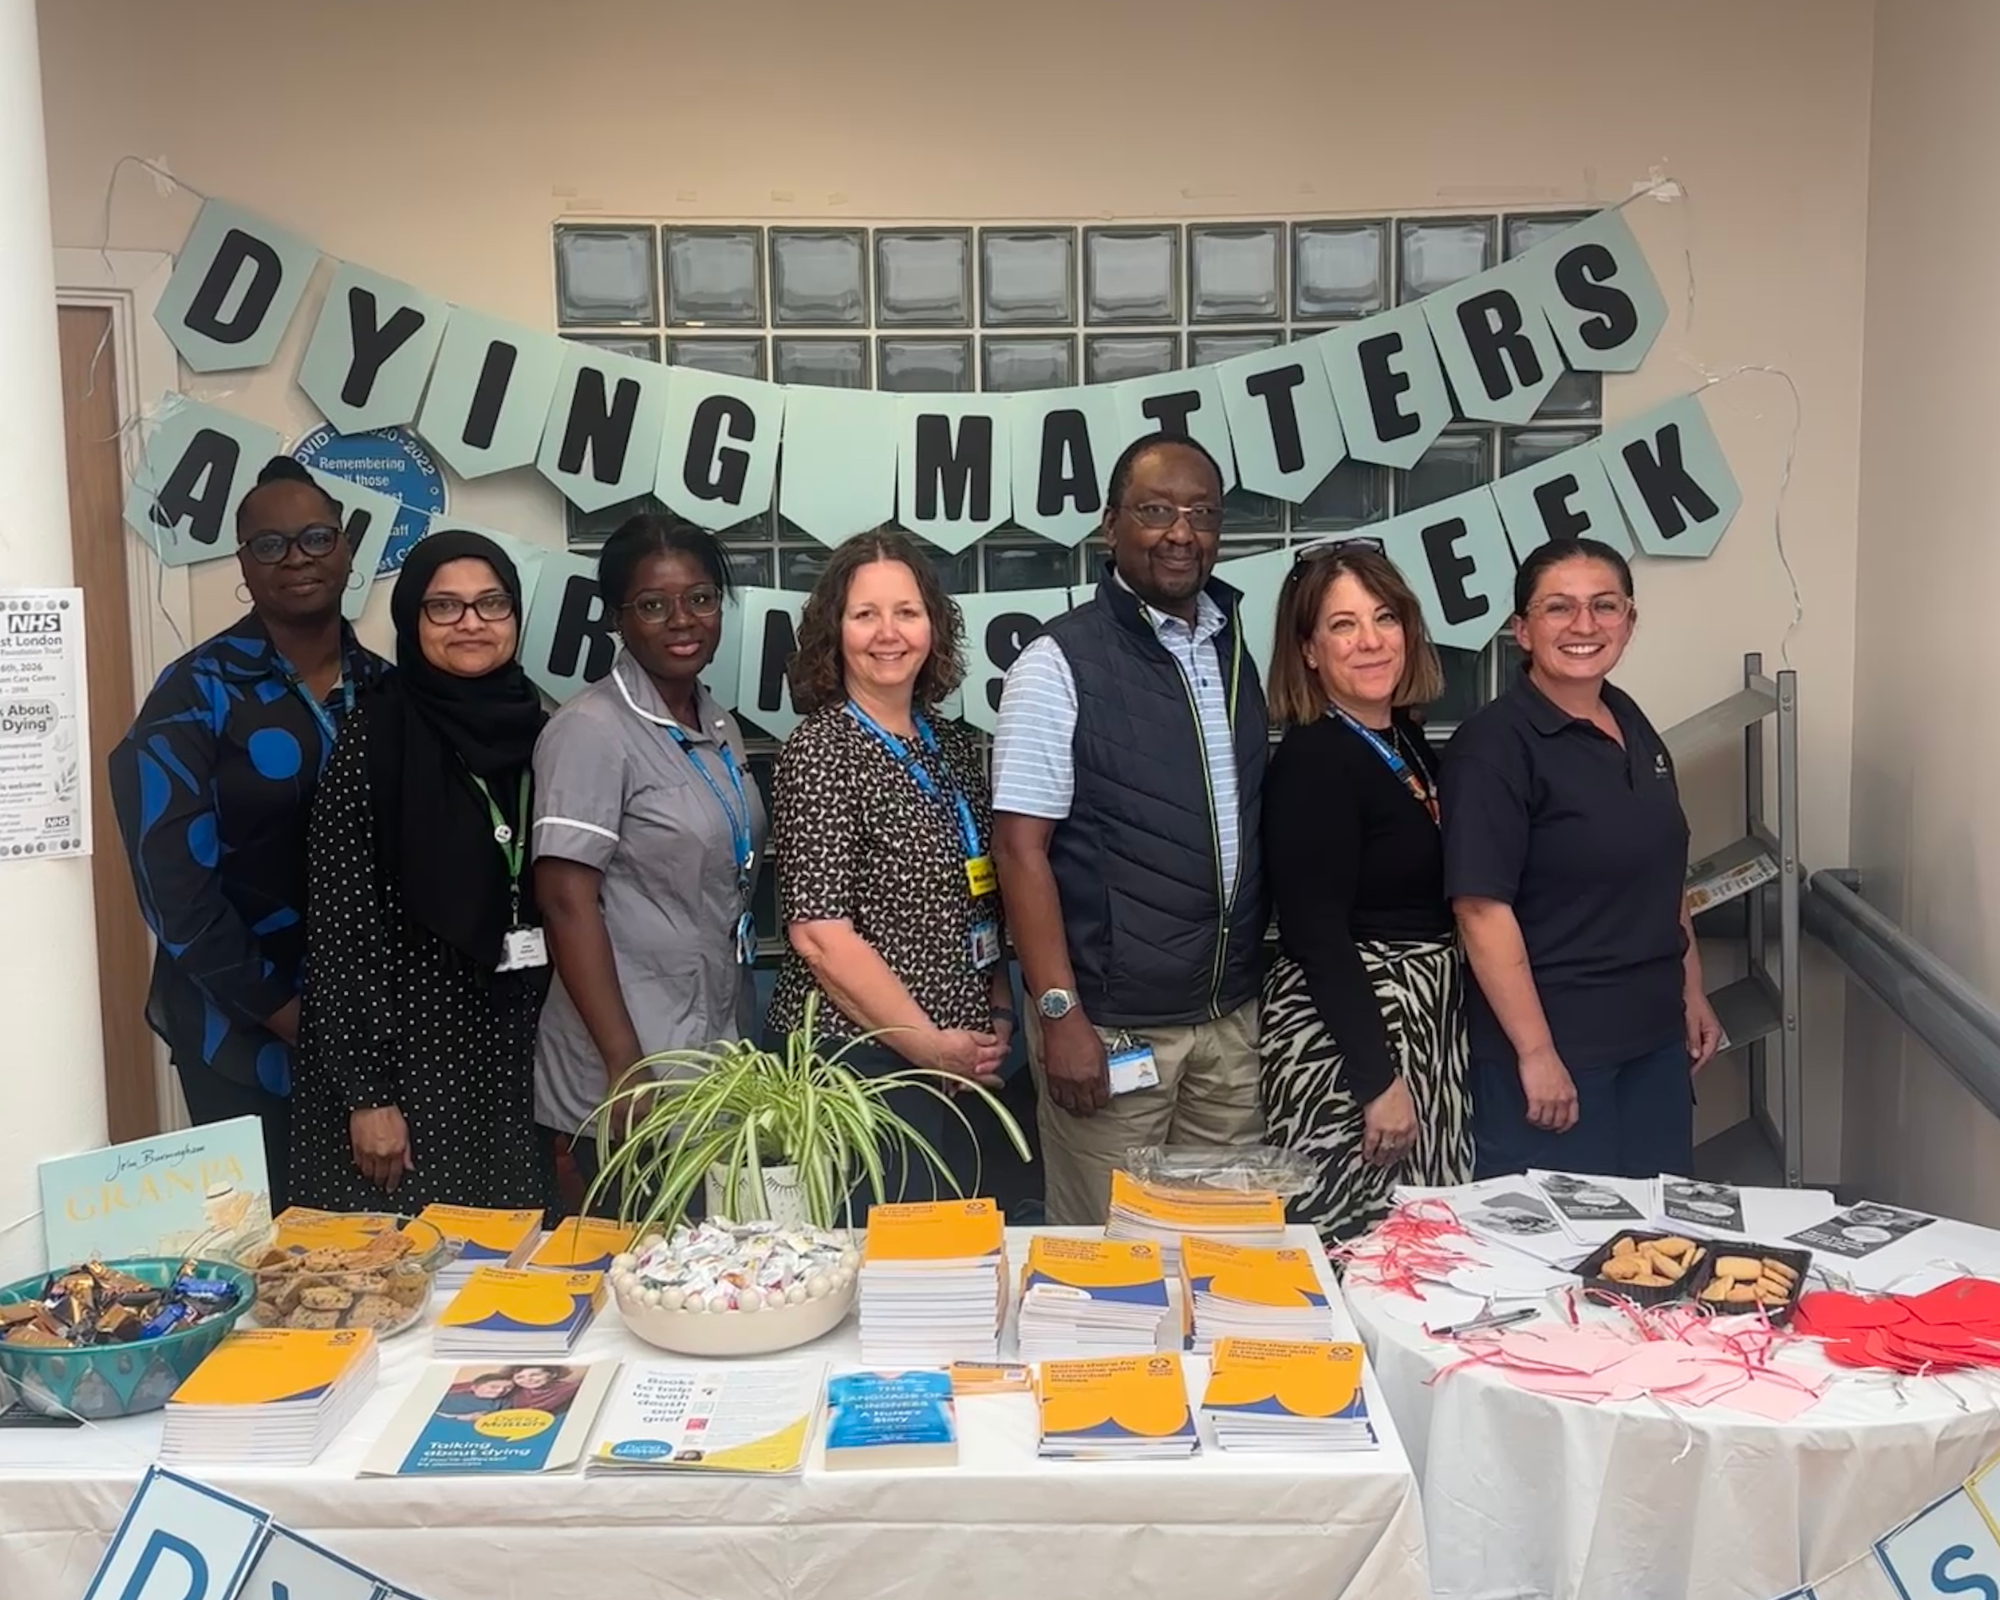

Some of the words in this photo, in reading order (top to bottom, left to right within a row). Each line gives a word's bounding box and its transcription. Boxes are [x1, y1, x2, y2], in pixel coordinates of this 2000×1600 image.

[184, 228, 756, 506] DYING
[319, 456, 406, 472] Remembering
[355, 474, 390, 487] those
[1421, 423, 1719, 626] EEK
[11, 614, 59, 632] NHS
[16, 634, 63, 647] London
[8, 704, 50, 716] About
[647, 1376, 695, 1386] Books
[636, 1382, 653, 1391] to
[657, 1386, 692, 1394] help
[632, 1391, 650, 1399] us
[655, 1392, 690, 1401] with
[637, 1399, 687, 1408] death
[651, 1407, 684, 1416] and
[642, 1415, 682, 1424] grief
[430, 1441, 492, 1450] Talking
[423, 1449, 479, 1457] about
[481, 1447, 532, 1457] dying
